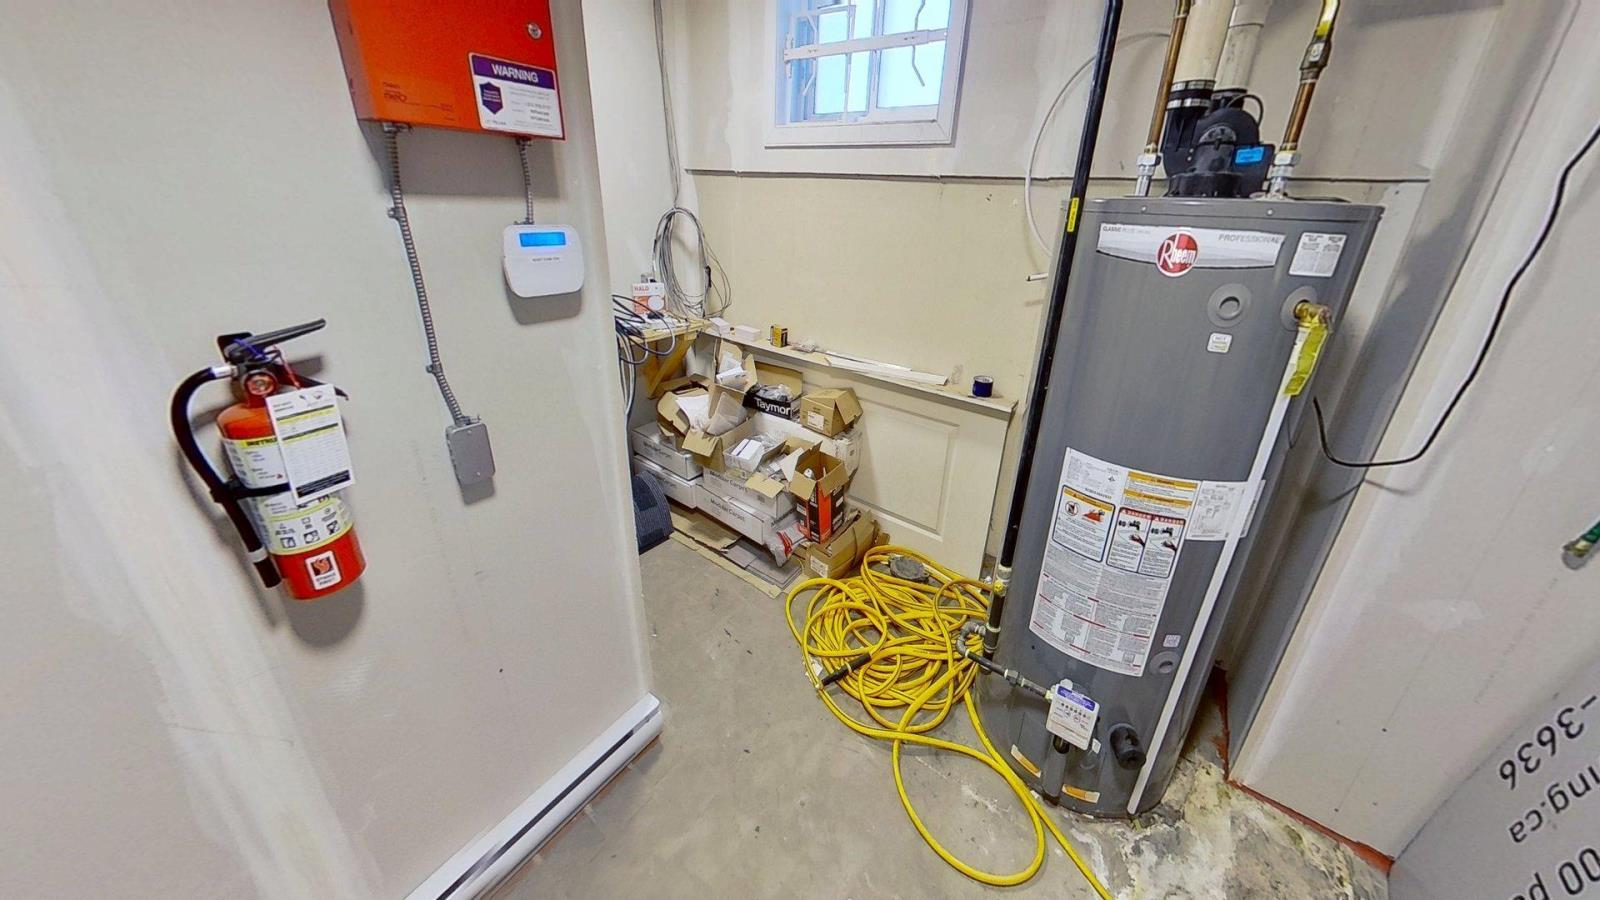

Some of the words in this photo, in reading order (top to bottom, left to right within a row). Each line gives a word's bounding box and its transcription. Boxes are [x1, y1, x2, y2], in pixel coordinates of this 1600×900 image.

[492, 63, 539, 84] WARNING
[1218, 233, 1282, 244] PROFESSIONAL
[1160, 232, 1197, 269] Rheem
[755, 397, 792, 417] Taymor
[728, 508, 746, 521] Carpet
[1513, 872, 1549, 900] p
